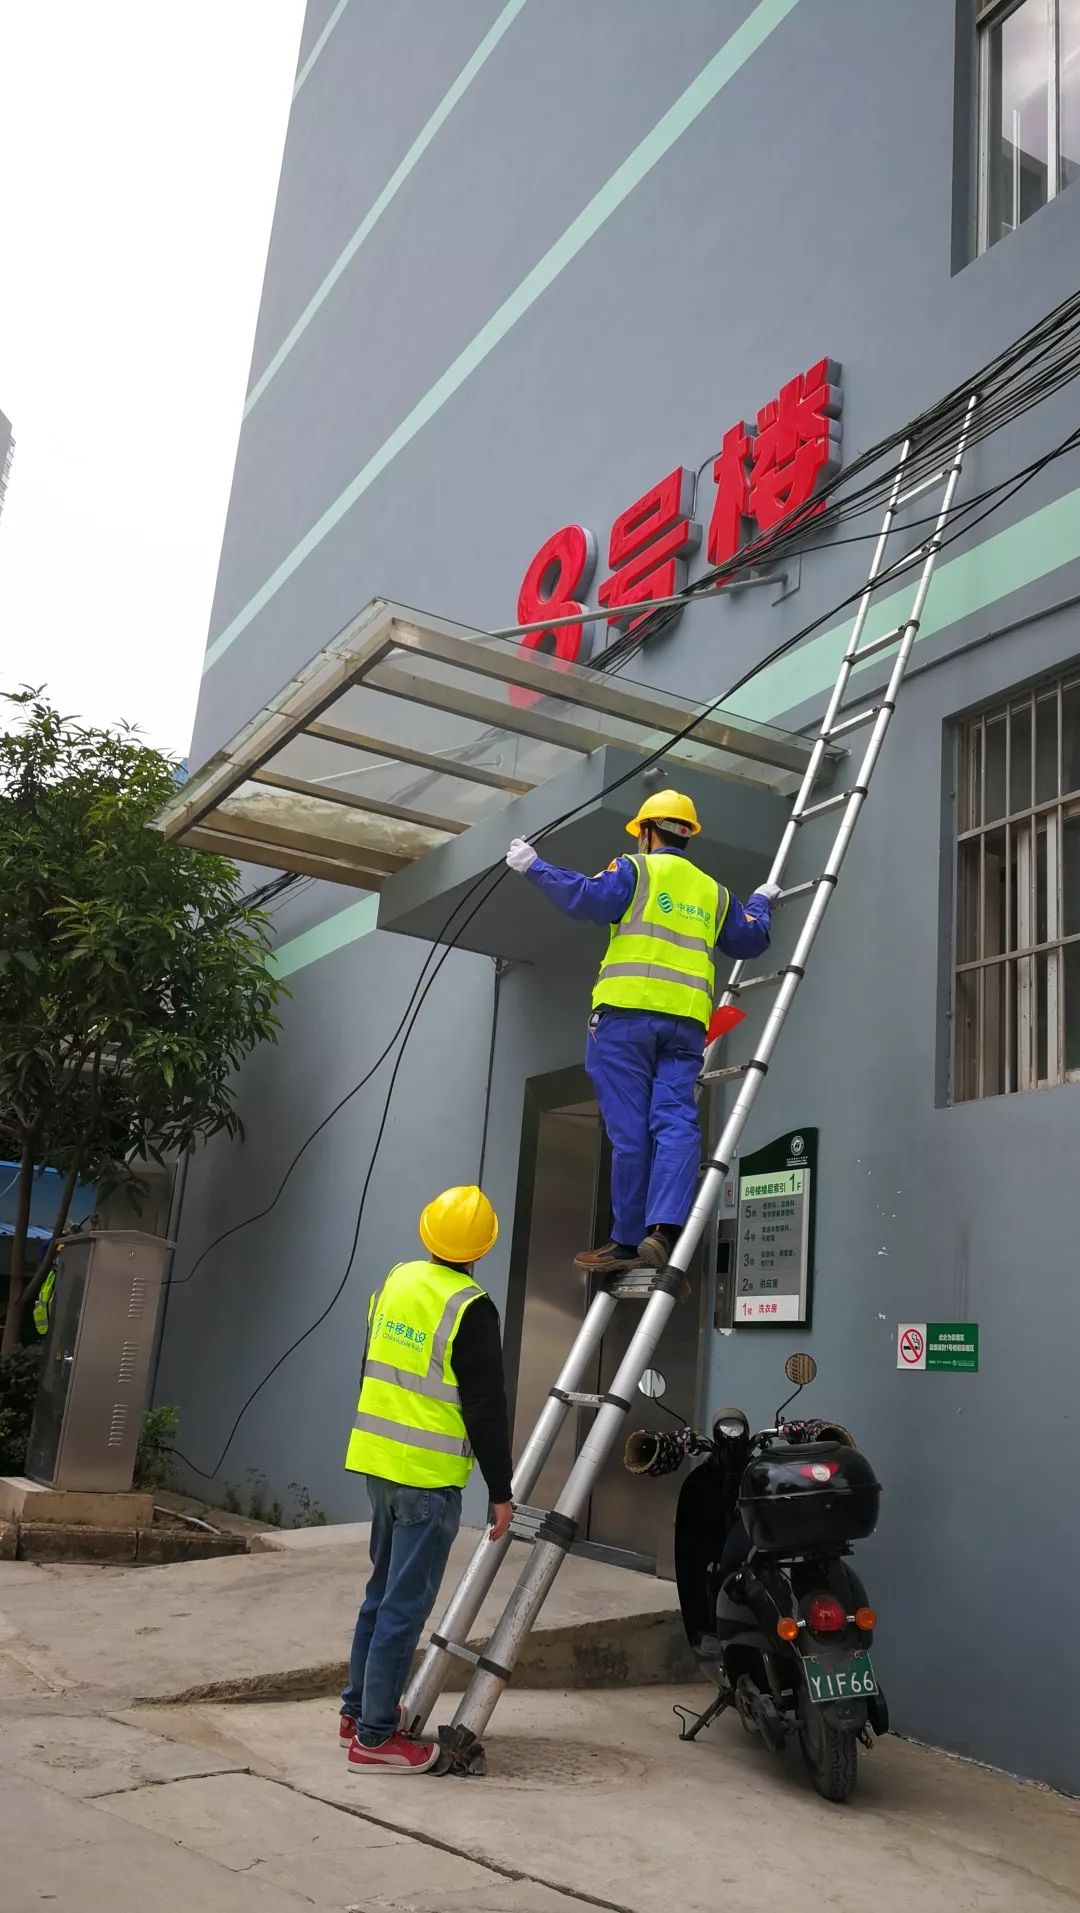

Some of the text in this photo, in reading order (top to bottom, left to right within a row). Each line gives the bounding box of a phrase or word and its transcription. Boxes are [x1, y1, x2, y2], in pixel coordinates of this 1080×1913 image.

[507, 356, 830, 709] 8号楼
[745, 1182, 786, 1197] 8号楼楼层索引
[758, 1304, 777, 1313] 洗衣房
[386, 1320, 427, 1345] 中移建设
